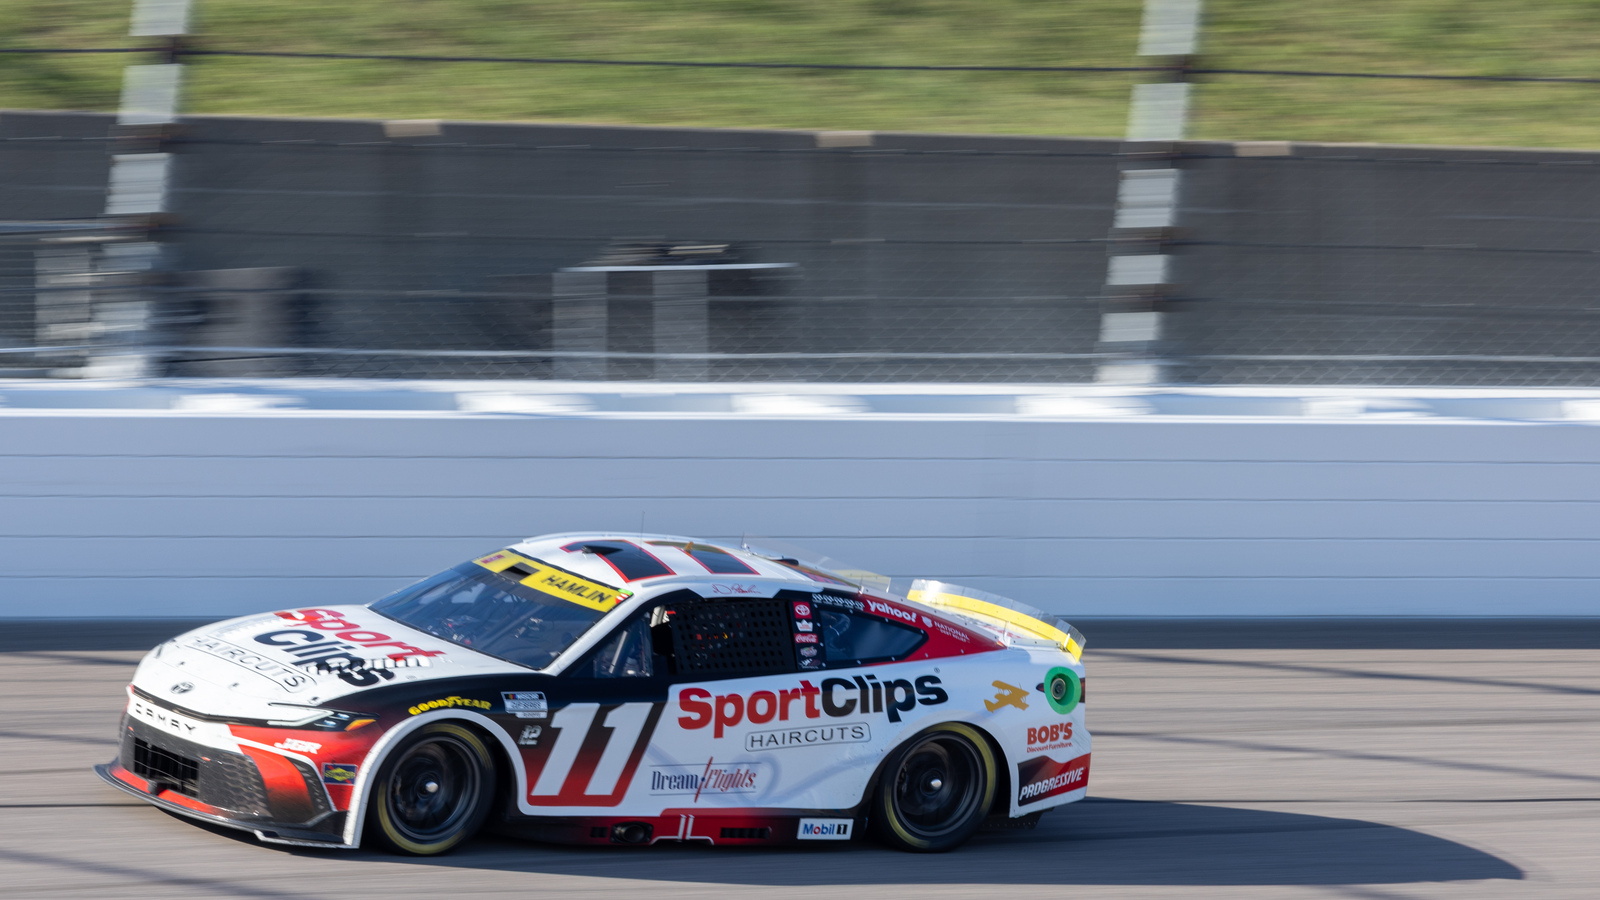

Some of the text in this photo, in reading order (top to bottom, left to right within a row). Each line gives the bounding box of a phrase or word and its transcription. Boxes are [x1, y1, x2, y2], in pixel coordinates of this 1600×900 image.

[541, 574, 613, 604] HAMLIN
[866, 599, 917, 623] yahoo!
[273, 609, 447, 663] Sport
[934, 620, 970, 641] NATIONAL
[195, 636, 305, 687] HAIRCUTS
[253, 630, 396, 687] Clips
[408, 696, 492, 716] GOODYEAR
[750, 725, 865, 748] HAIRCUTS
[1027, 722, 1073, 745] BOB'S
[530, 702, 654, 796] 11
[1026, 745, 1049, 753] Discount
[651, 771, 699, 791] Dream
[1019, 767, 1084, 801] PROGRESSIVE
[803, 822, 848, 836] Mobil 1
